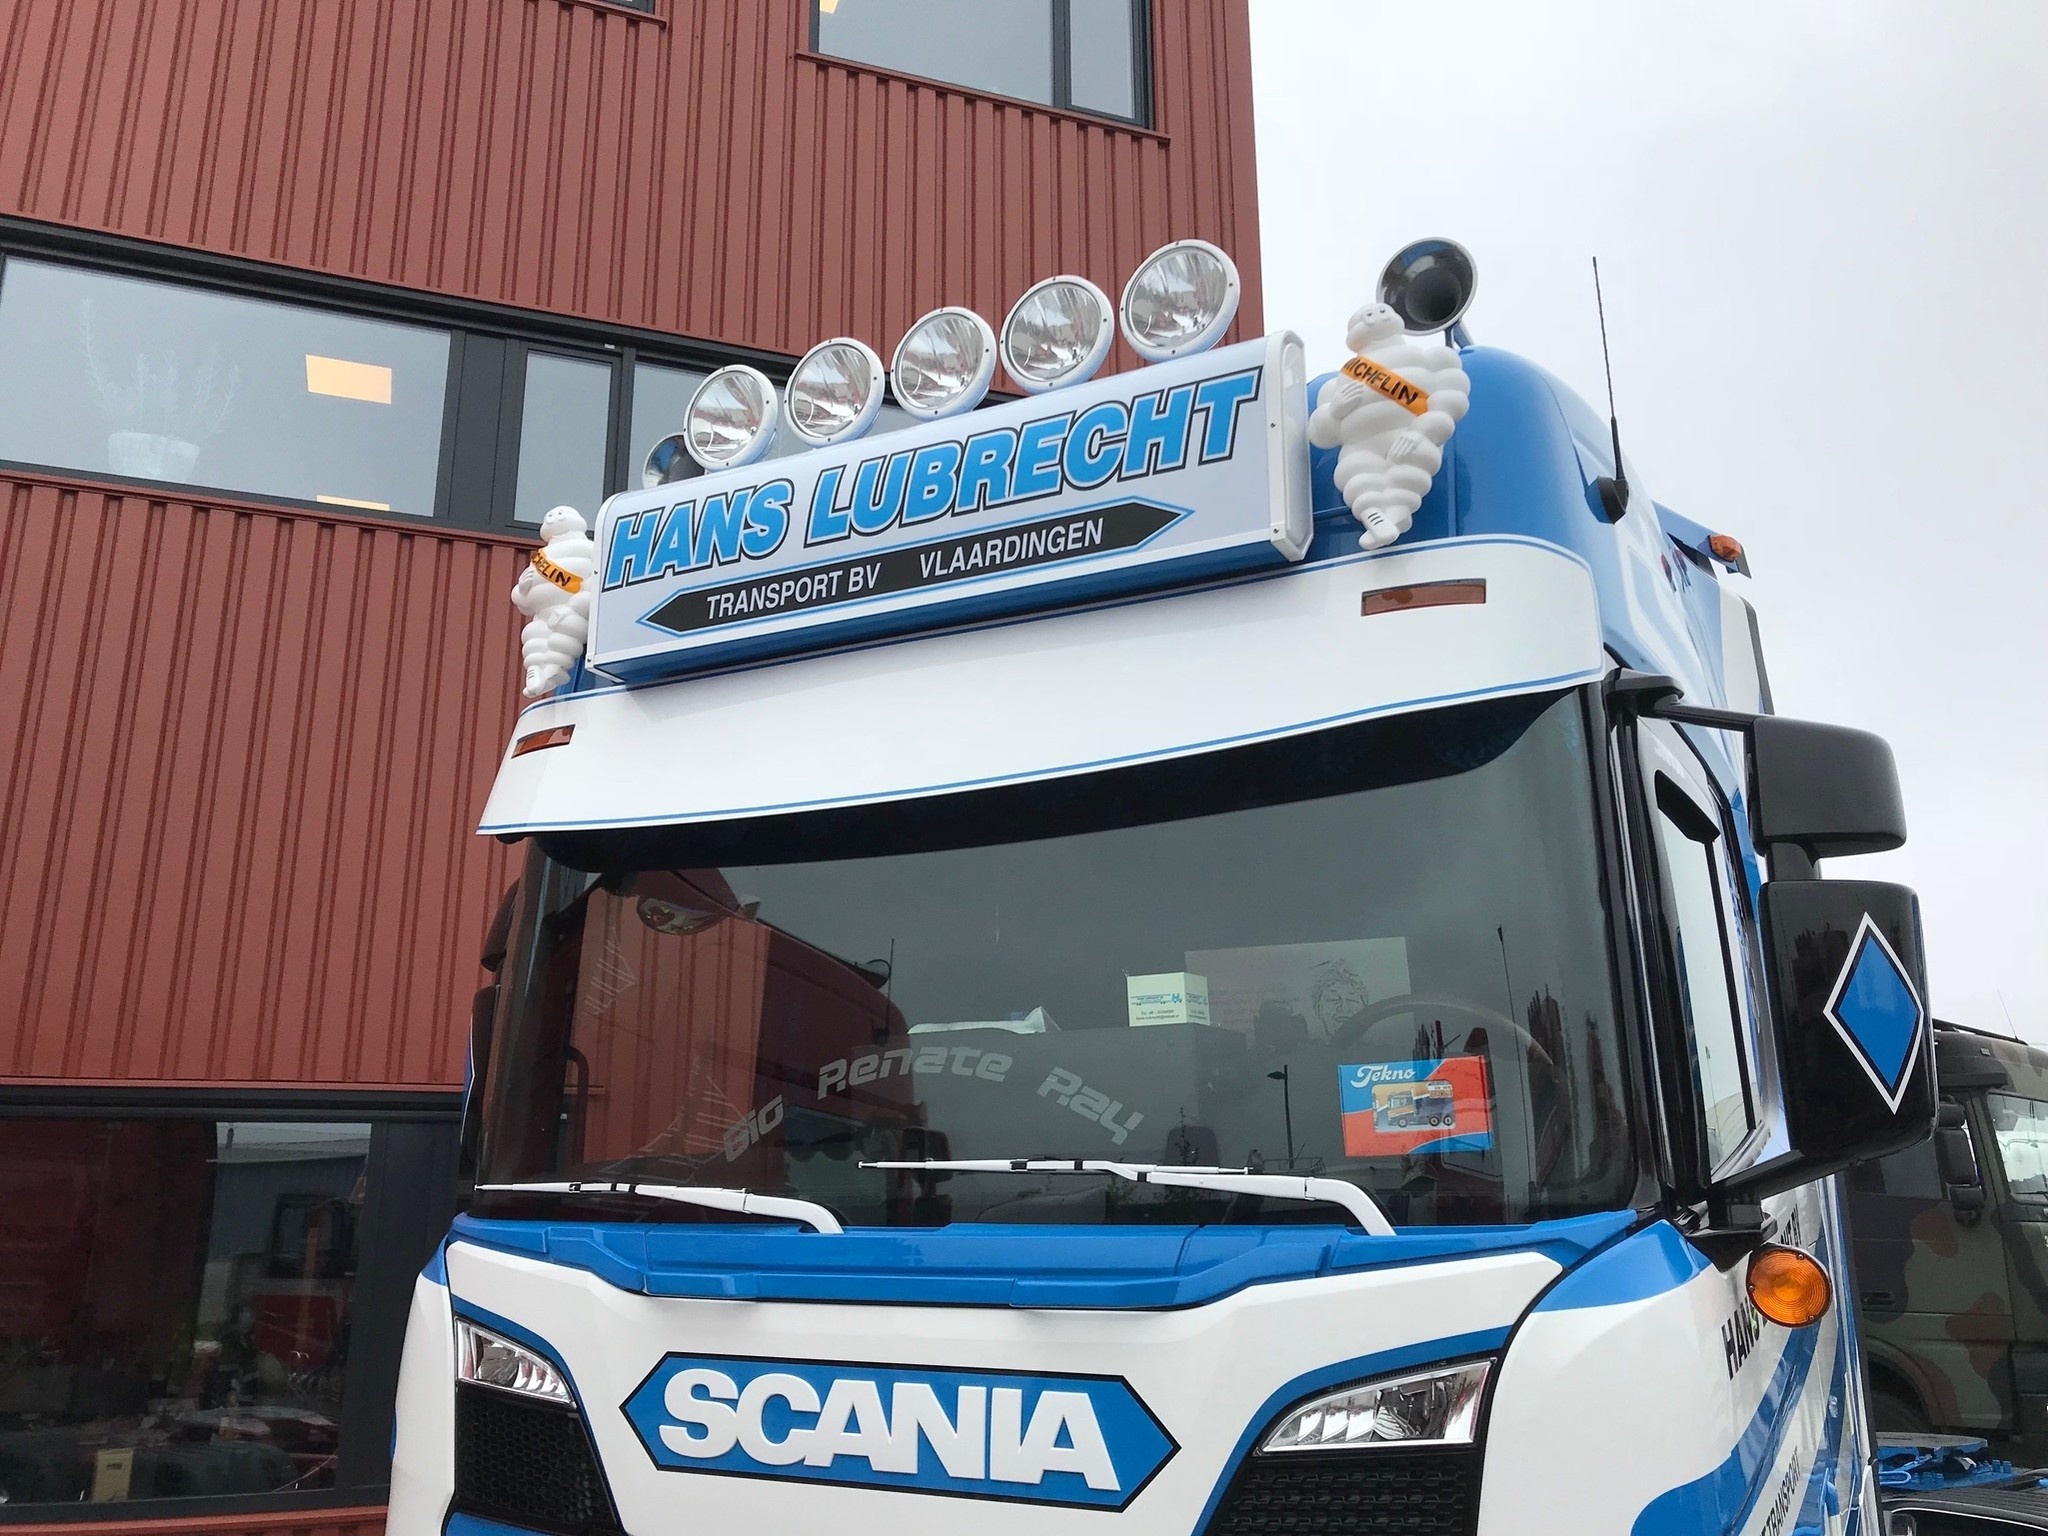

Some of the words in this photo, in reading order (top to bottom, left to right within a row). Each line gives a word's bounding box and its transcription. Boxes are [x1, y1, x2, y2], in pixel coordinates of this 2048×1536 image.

[602, 478, 796, 592] HANS
[804, 366, 1263, 547] LUBRECHT
[706, 570, 844, 621] TRANSPORT
[848, 562, 881, 594] BV
[919, 518, 1104, 579] VLAARDINGEN
[817, 1046, 1013, 1100] Renate
[1036, 1067, 1145, 1146] Ray
[1350, 1064, 1416, 1088] Tekno
[658, 1368, 1121, 1491] SCANIA
